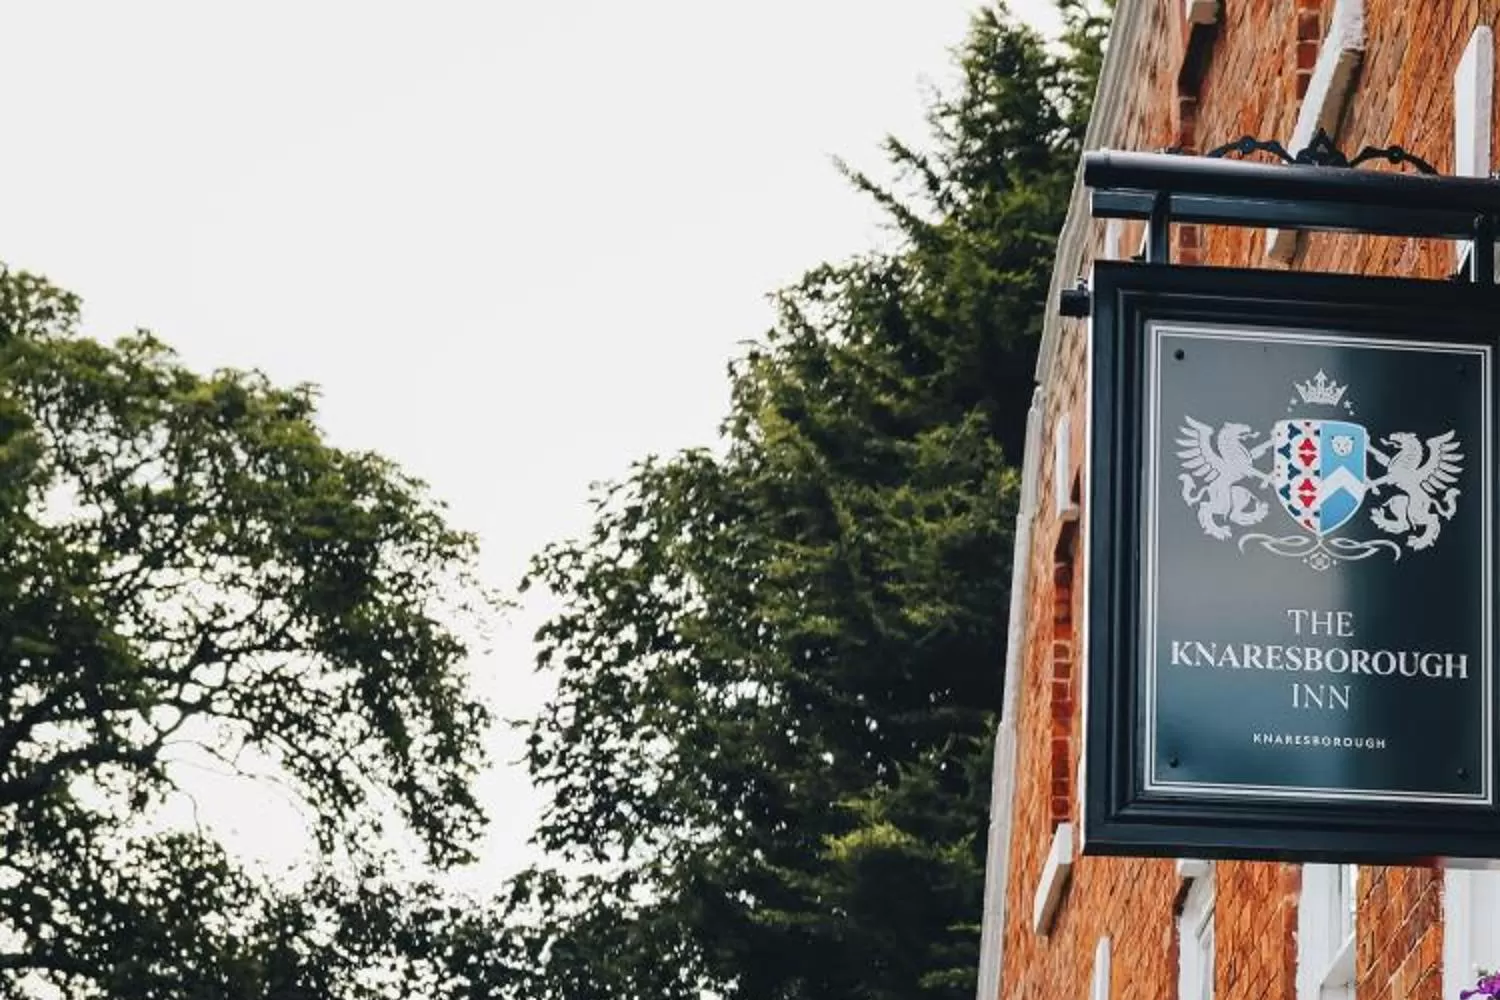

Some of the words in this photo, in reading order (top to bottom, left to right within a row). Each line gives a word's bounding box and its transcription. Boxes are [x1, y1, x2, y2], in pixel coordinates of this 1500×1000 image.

[1287, 609, 1355, 637] THE
[1170, 641, 1469, 679] KNARESBOROUGH
[1291, 683, 1351, 710] INN
[1252, 733, 1386, 749] KNARESBOROUGH
